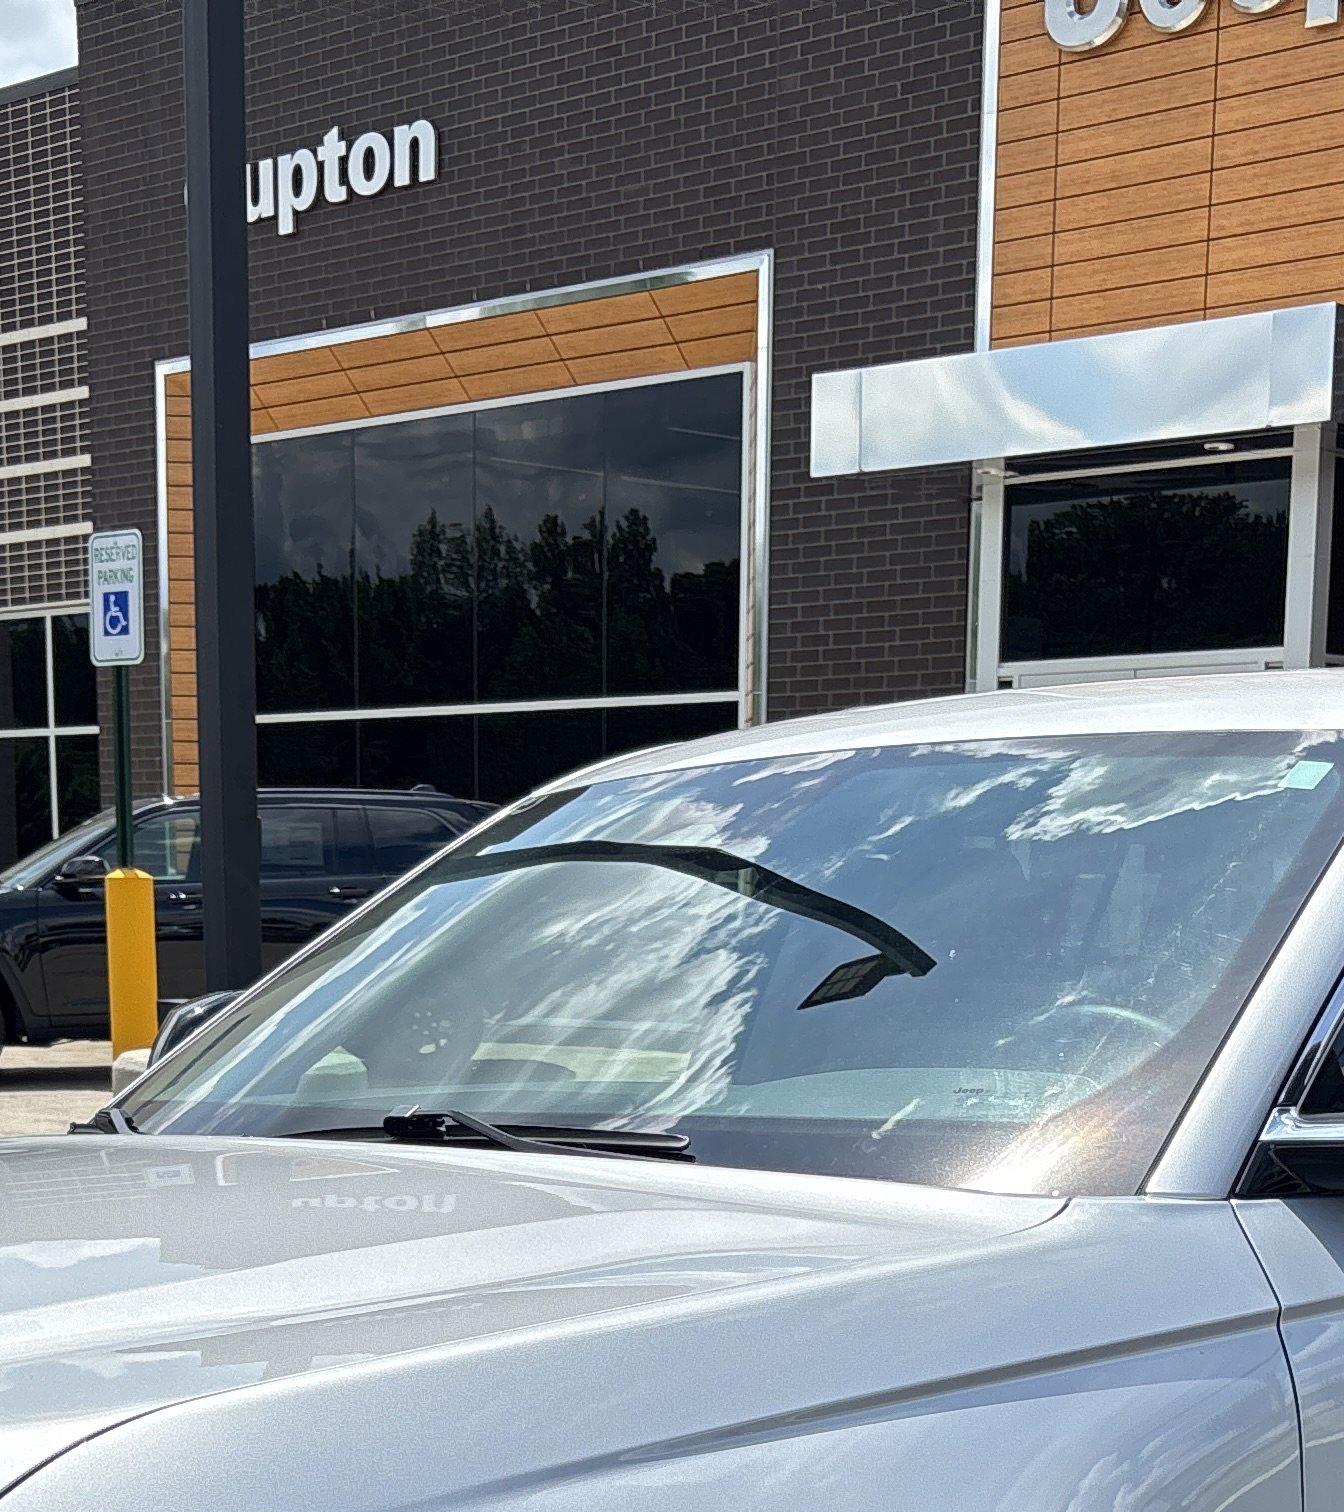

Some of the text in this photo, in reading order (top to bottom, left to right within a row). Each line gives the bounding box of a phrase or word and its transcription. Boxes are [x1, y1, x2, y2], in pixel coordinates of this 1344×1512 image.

[184, 119, 438, 236] upton
[94, 544, 137, 563] RESERVED
[97, 567, 134, 586] PARKING
